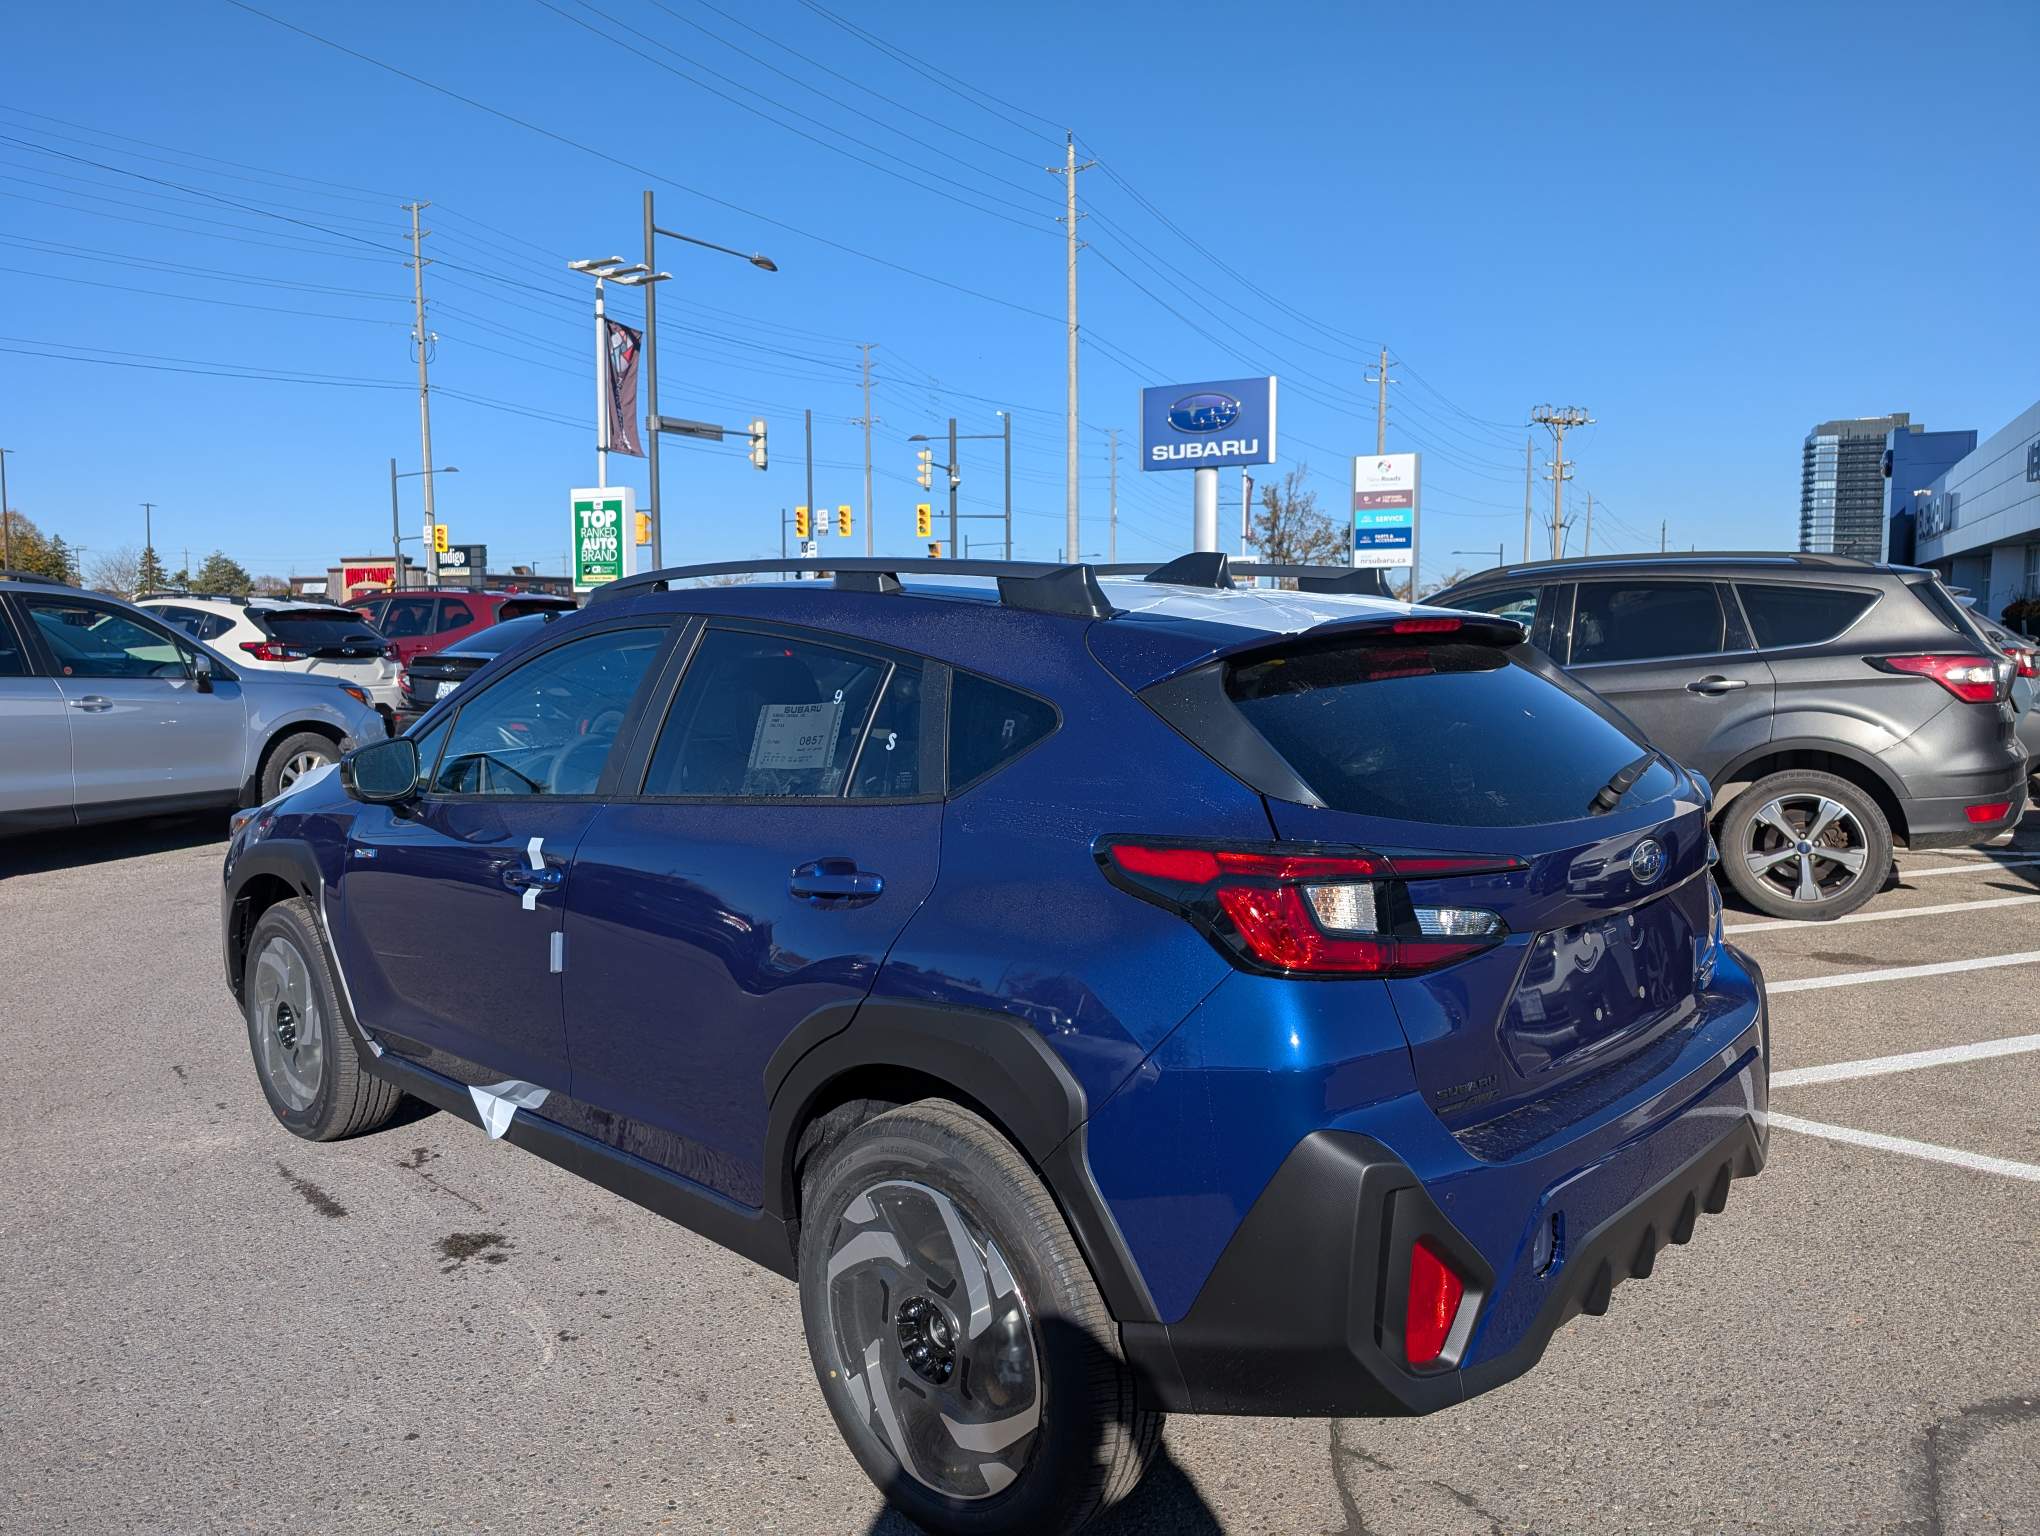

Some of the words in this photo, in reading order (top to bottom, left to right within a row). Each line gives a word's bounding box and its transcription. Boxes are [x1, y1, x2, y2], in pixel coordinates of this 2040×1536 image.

[1152, 438, 1259, 461] SUBARU
[580, 510, 617, 528] TOP
[581, 527, 618, 538] RANKED
[582, 537, 618, 550] AUTO
[581, 549, 618, 562] BRAND
[833, 689, 843, 705] 9
[784, 704, 823, 714] SUBARU
[1002, 719, 1016, 737] R
[799, 734, 825, 746] 0857
[1436, 1074, 1498, 1100] SUBARU
